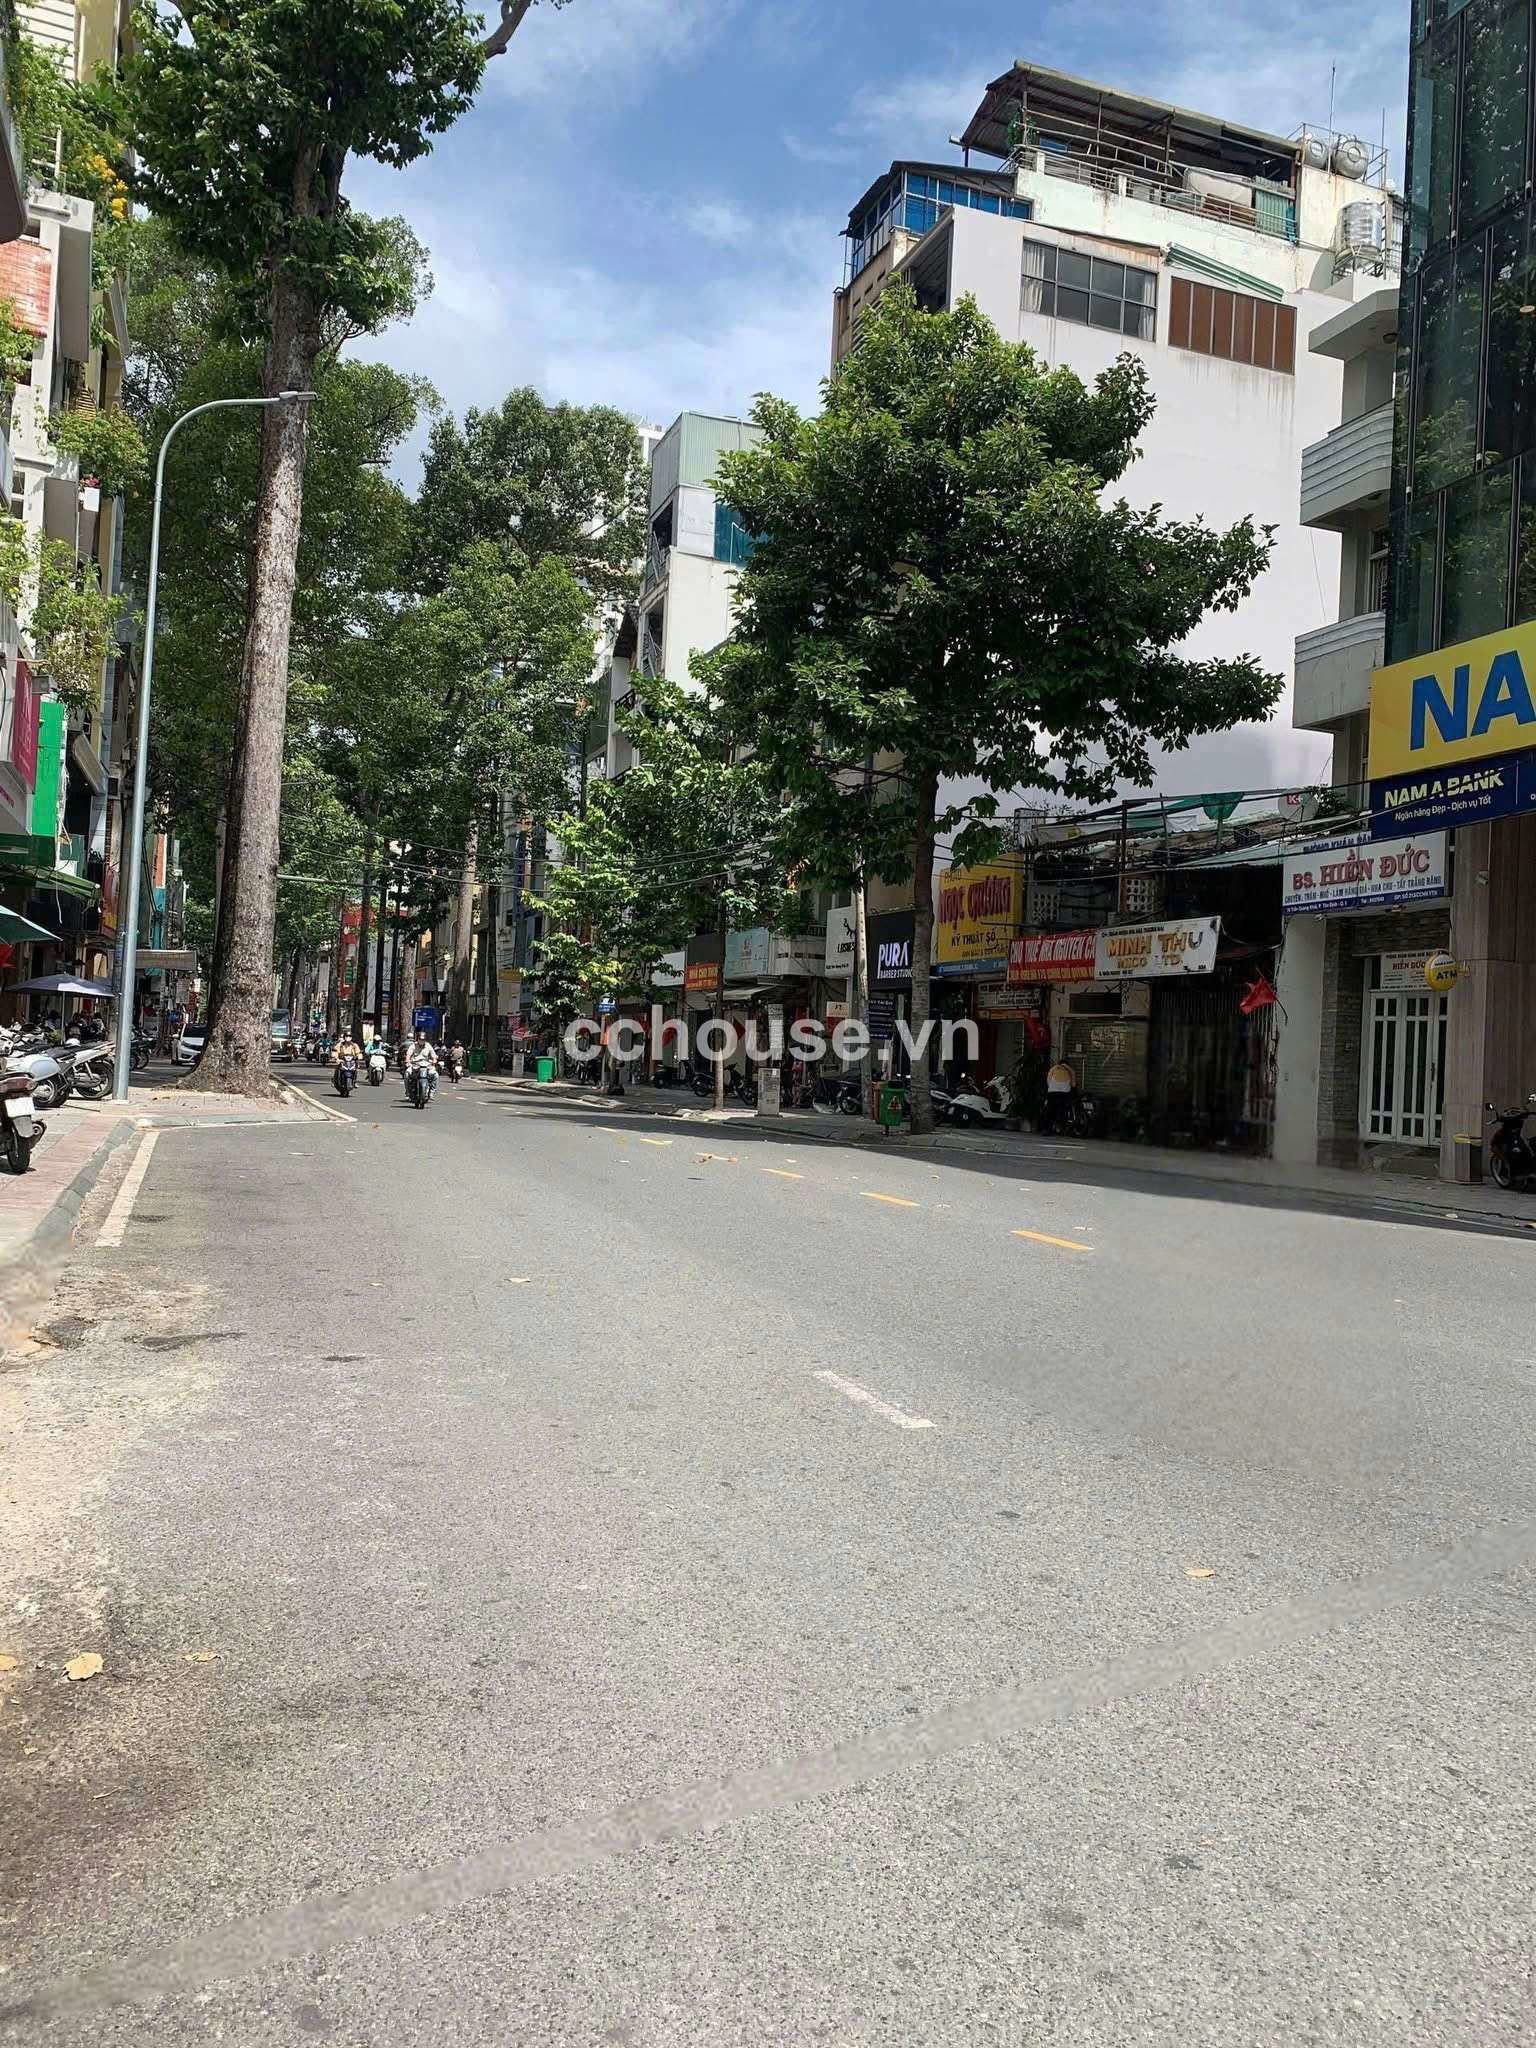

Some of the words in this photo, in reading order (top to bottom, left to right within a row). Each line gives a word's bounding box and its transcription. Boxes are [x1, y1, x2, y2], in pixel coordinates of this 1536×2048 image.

[1384, 781, 1428, 808] NAM
[1429, 778, 1445, 800] A
[1446, 767, 1505, 797] BANK
[1293, 872, 1317, 890] BS.
[1319, 849, 1375, 886] HIỀN
[1379, 843, 1431, 878] ĐỨC
[1104, 935, 1152, 957] MINH
[1436, 970, 1457, 980] ATM
